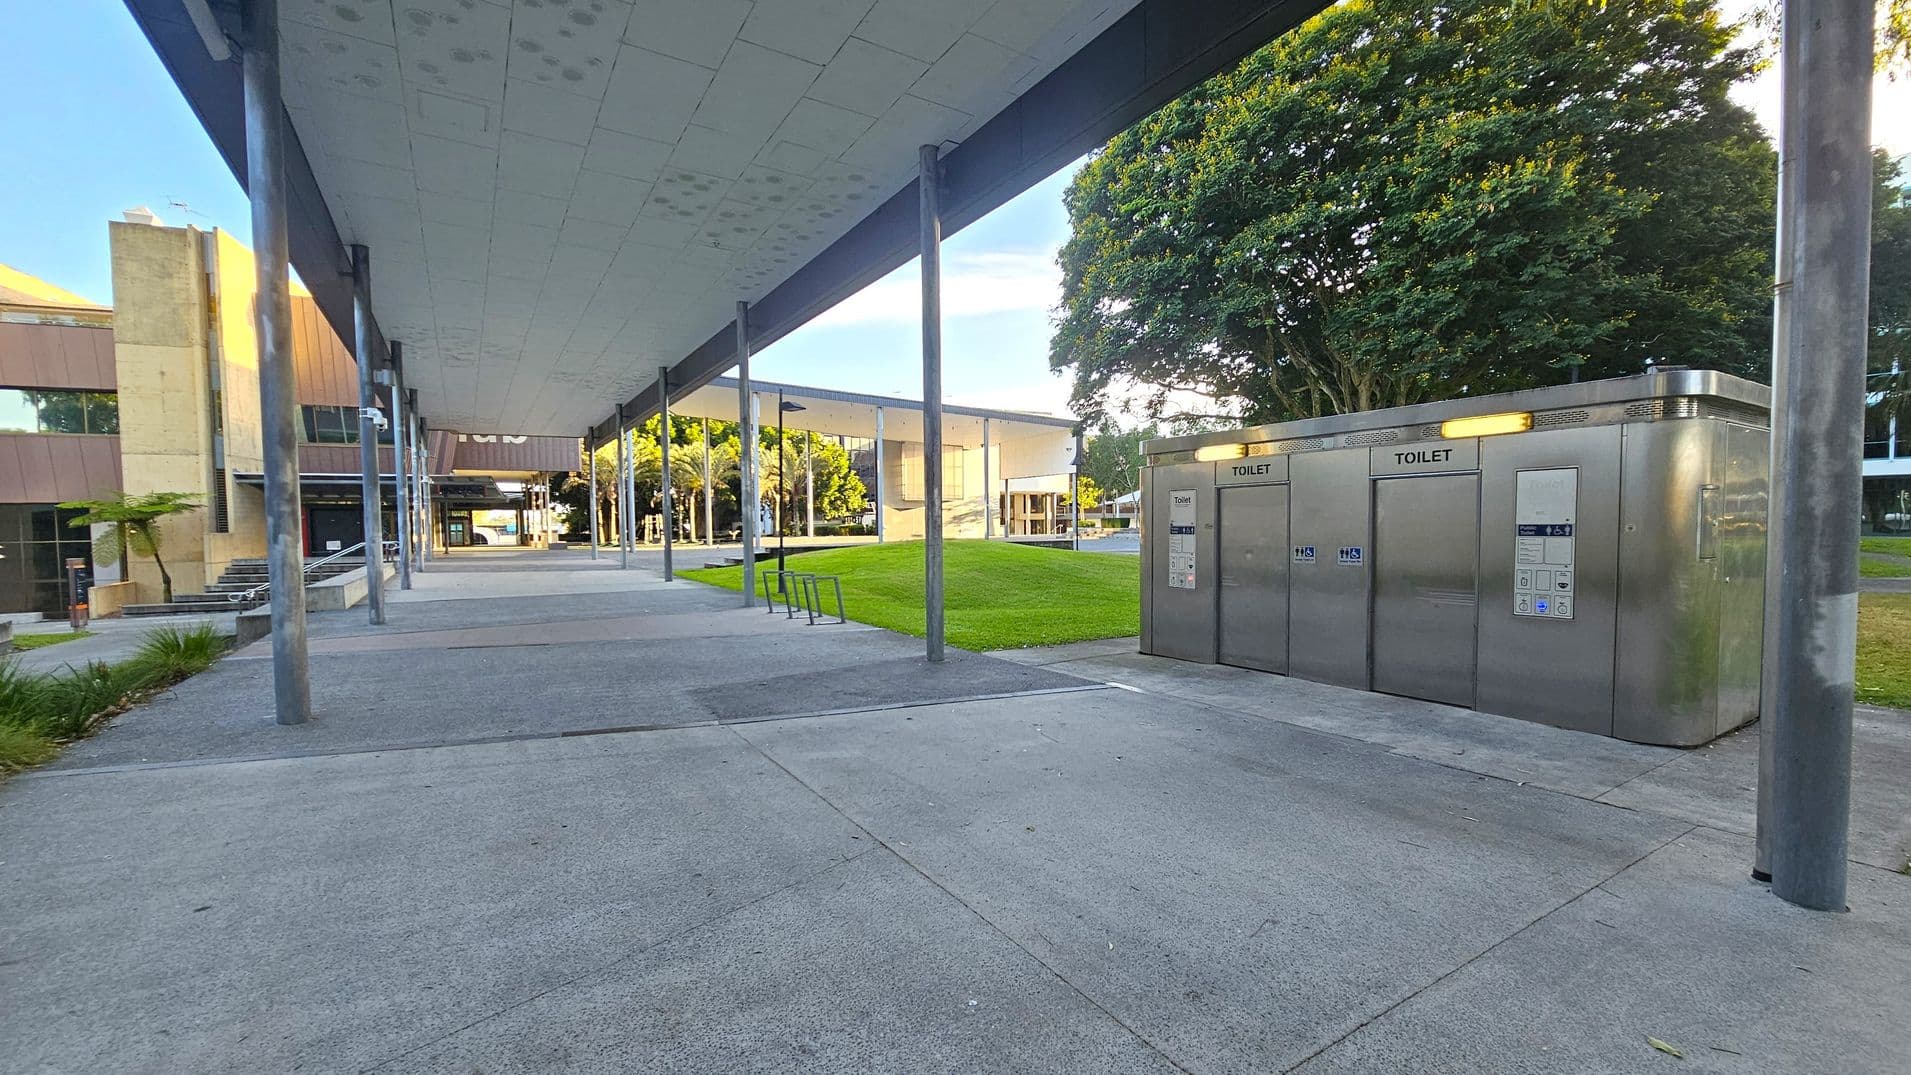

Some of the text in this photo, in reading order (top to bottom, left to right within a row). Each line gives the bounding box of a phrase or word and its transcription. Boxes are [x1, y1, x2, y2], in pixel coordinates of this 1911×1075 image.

[1395, 449, 1453, 464] TOILET
[1232, 464, 1271, 476] TOILET
[1174, 496, 1191, 504] Toilet
